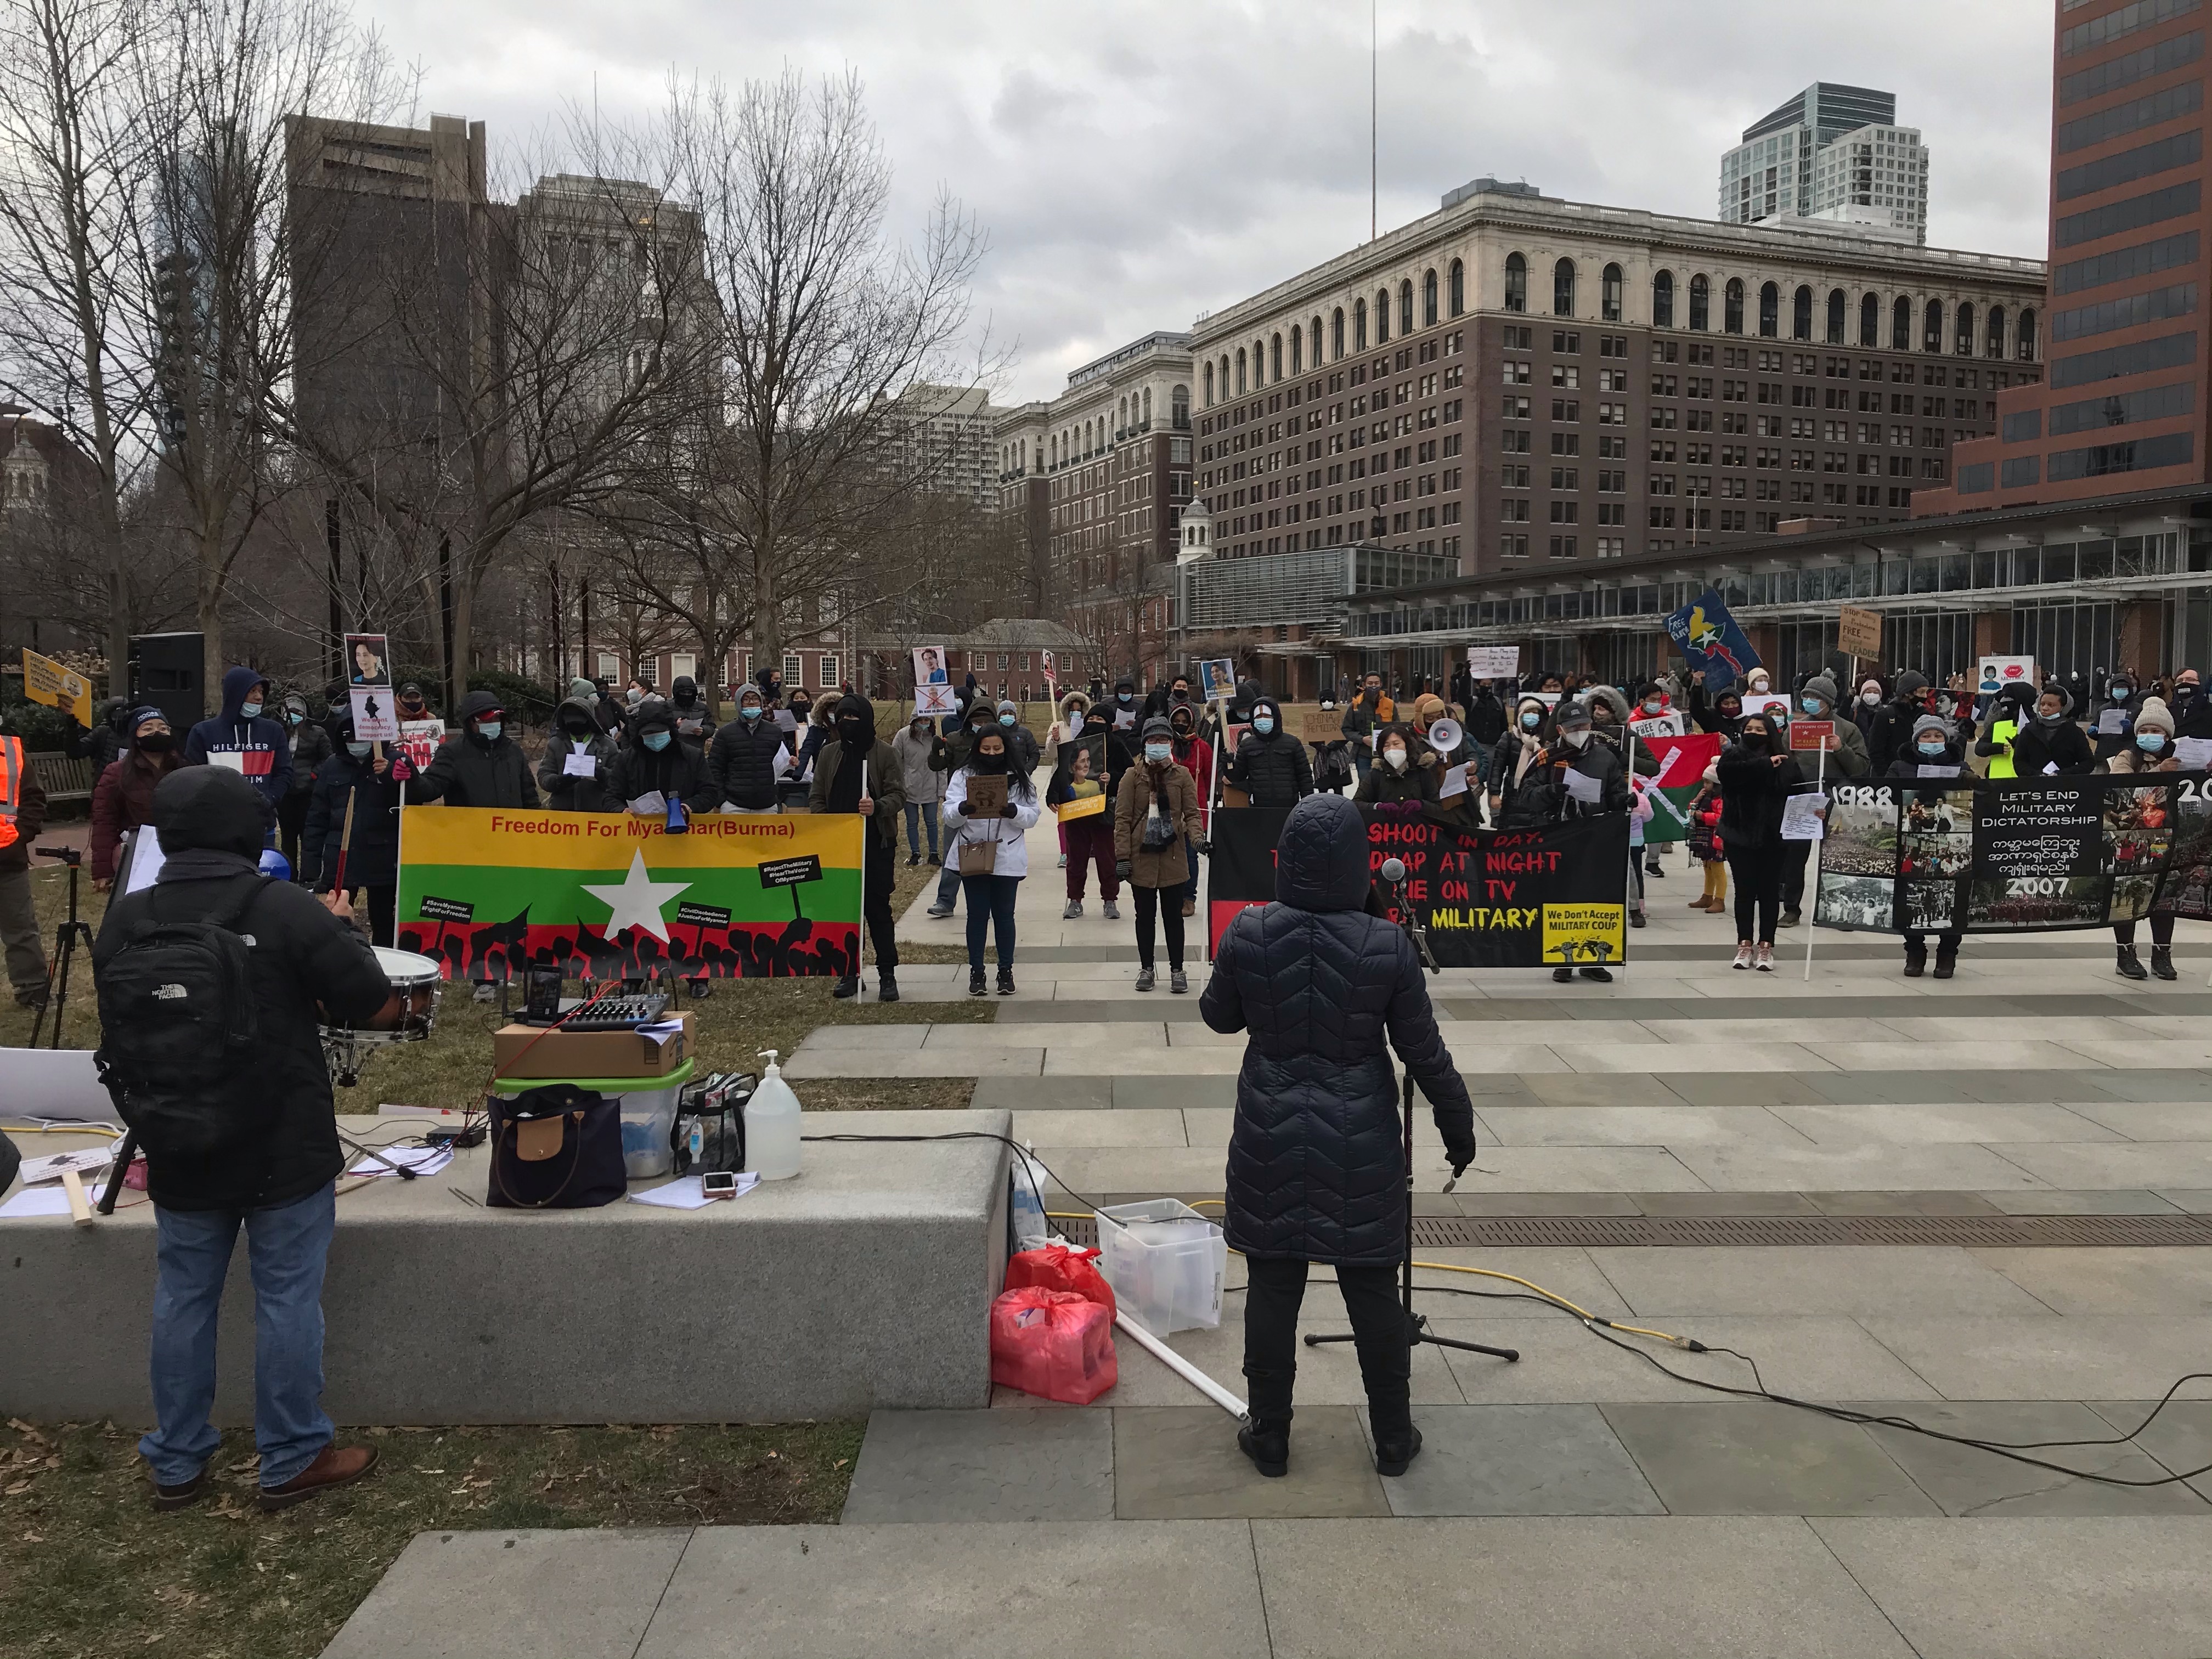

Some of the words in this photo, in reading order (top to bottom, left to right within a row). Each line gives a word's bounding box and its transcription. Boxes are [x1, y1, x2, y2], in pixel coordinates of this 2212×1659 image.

[1843, 625, 1861, 637] FREE
[1306, 714, 1333, 724] CHINA
[1635, 722, 1654, 735] FREE
[213, 743, 268, 752] HILFIGER
[1832, 786, 1893, 812] 1988
[2000, 791, 2041, 801] LET'S
[2046, 791, 2079, 800] END
[2002, 804, 2076, 813] MILITARY
[492, 816, 579, 836] Freedom
[587, 821, 622, 837] For
[1982, 816, 2097, 827] DICTATORSHIP
[1367, 823, 1443, 845] SHOOT
[1457, 834, 1479, 848] IN
[1493, 831, 1544, 848] DAY.
[763, 860, 812, 872] #RejectTheMilitary
[1440, 851, 1470, 873] AT
[1486, 851, 1562, 873] NIGHT
[769, 867, 809, 878] #HearTheVoice
[775, 874, 805, 883] OfMyanmar
[1441, 880, 1470, 901] ON
[1485, 879, 1516, 901] TV
[2006, 877, 2069, 898] 2007
[426, 900, 467, 912] #SaveMyanmar
[421, 906, 471, 919] #FightForFreedom
[678, 913, 729, 924] #JusticeForMyanmar
[681, 907, 727, 918] #CivilDisobedience
[1547, 910, 1562, 919] We
[1564, 910, 1588, 919] Don't
[1589, 910, 1620, 922] Accept
[1432, 908, 1538, 930] MILITARY
[1549, 921, 1590, 930] MILITARY
[1592, 921, 1617, 930] COUP
